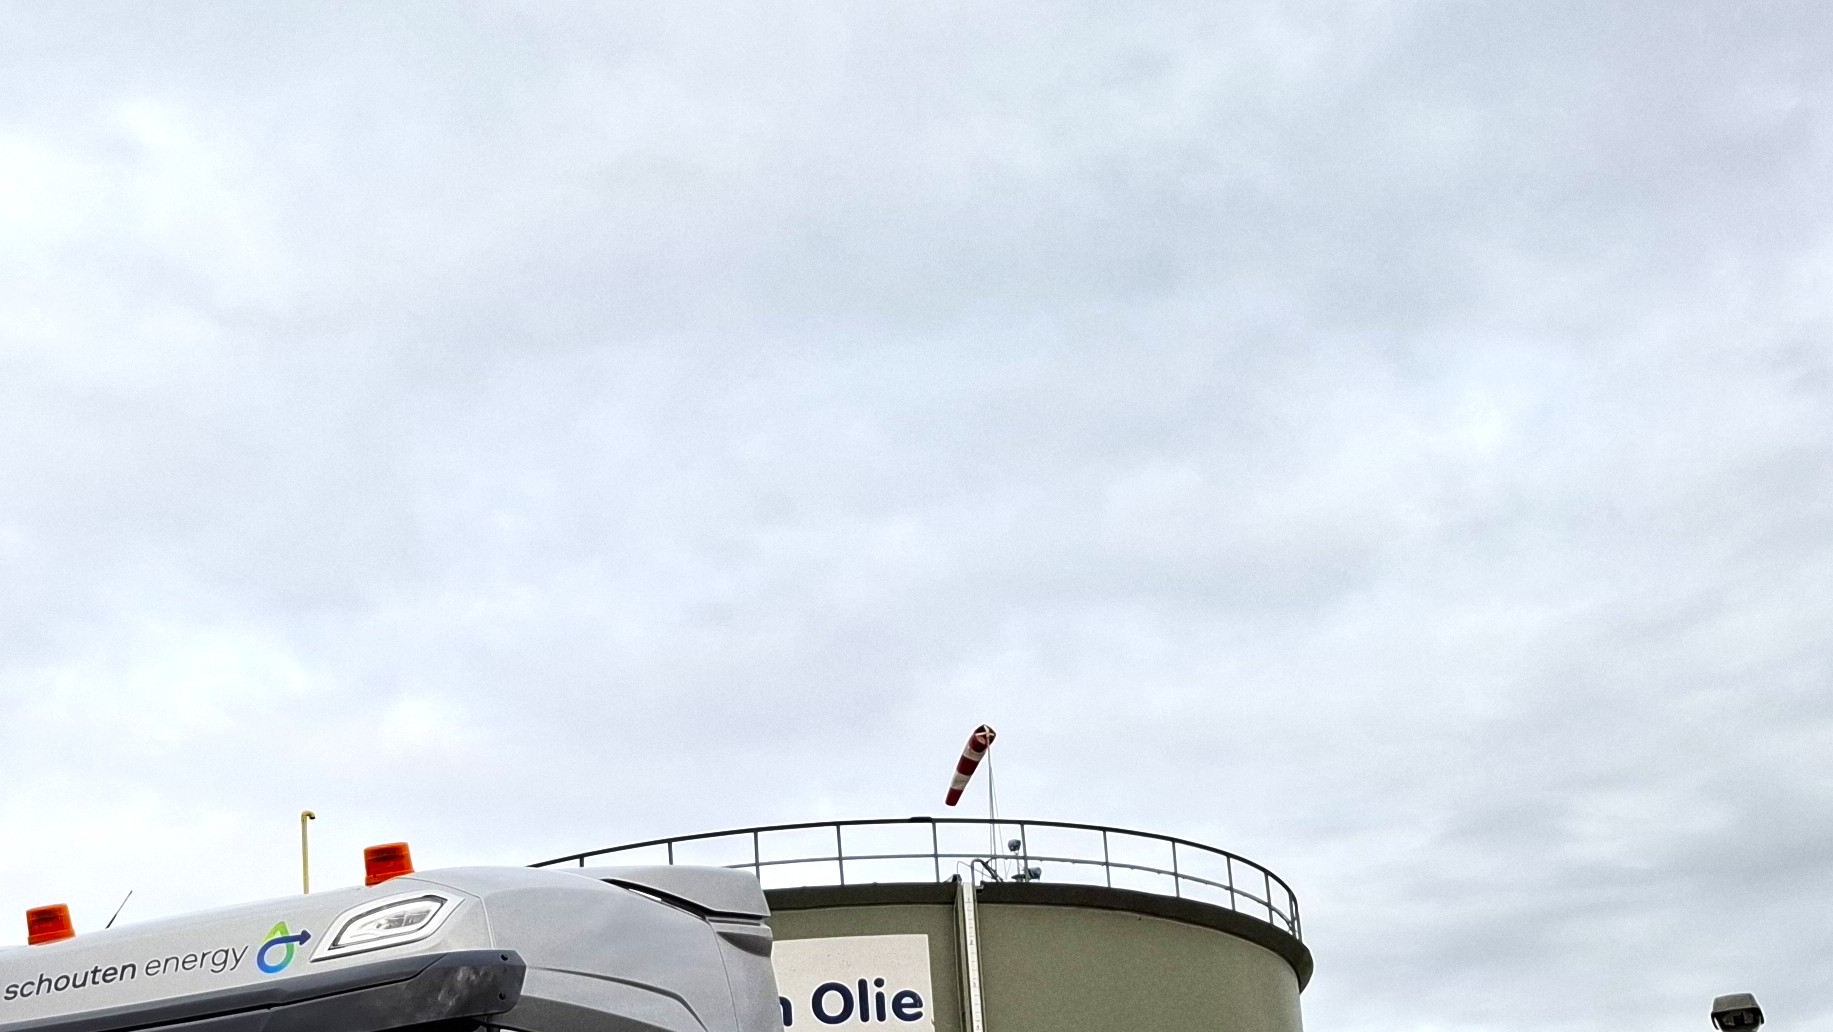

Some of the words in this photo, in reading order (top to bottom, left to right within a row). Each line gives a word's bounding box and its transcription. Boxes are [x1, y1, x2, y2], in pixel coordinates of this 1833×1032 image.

[3, 960, 137, 1001] schouten
[144, 943, 249, 978] energy
[811, 977, 924, 1025] Olie
